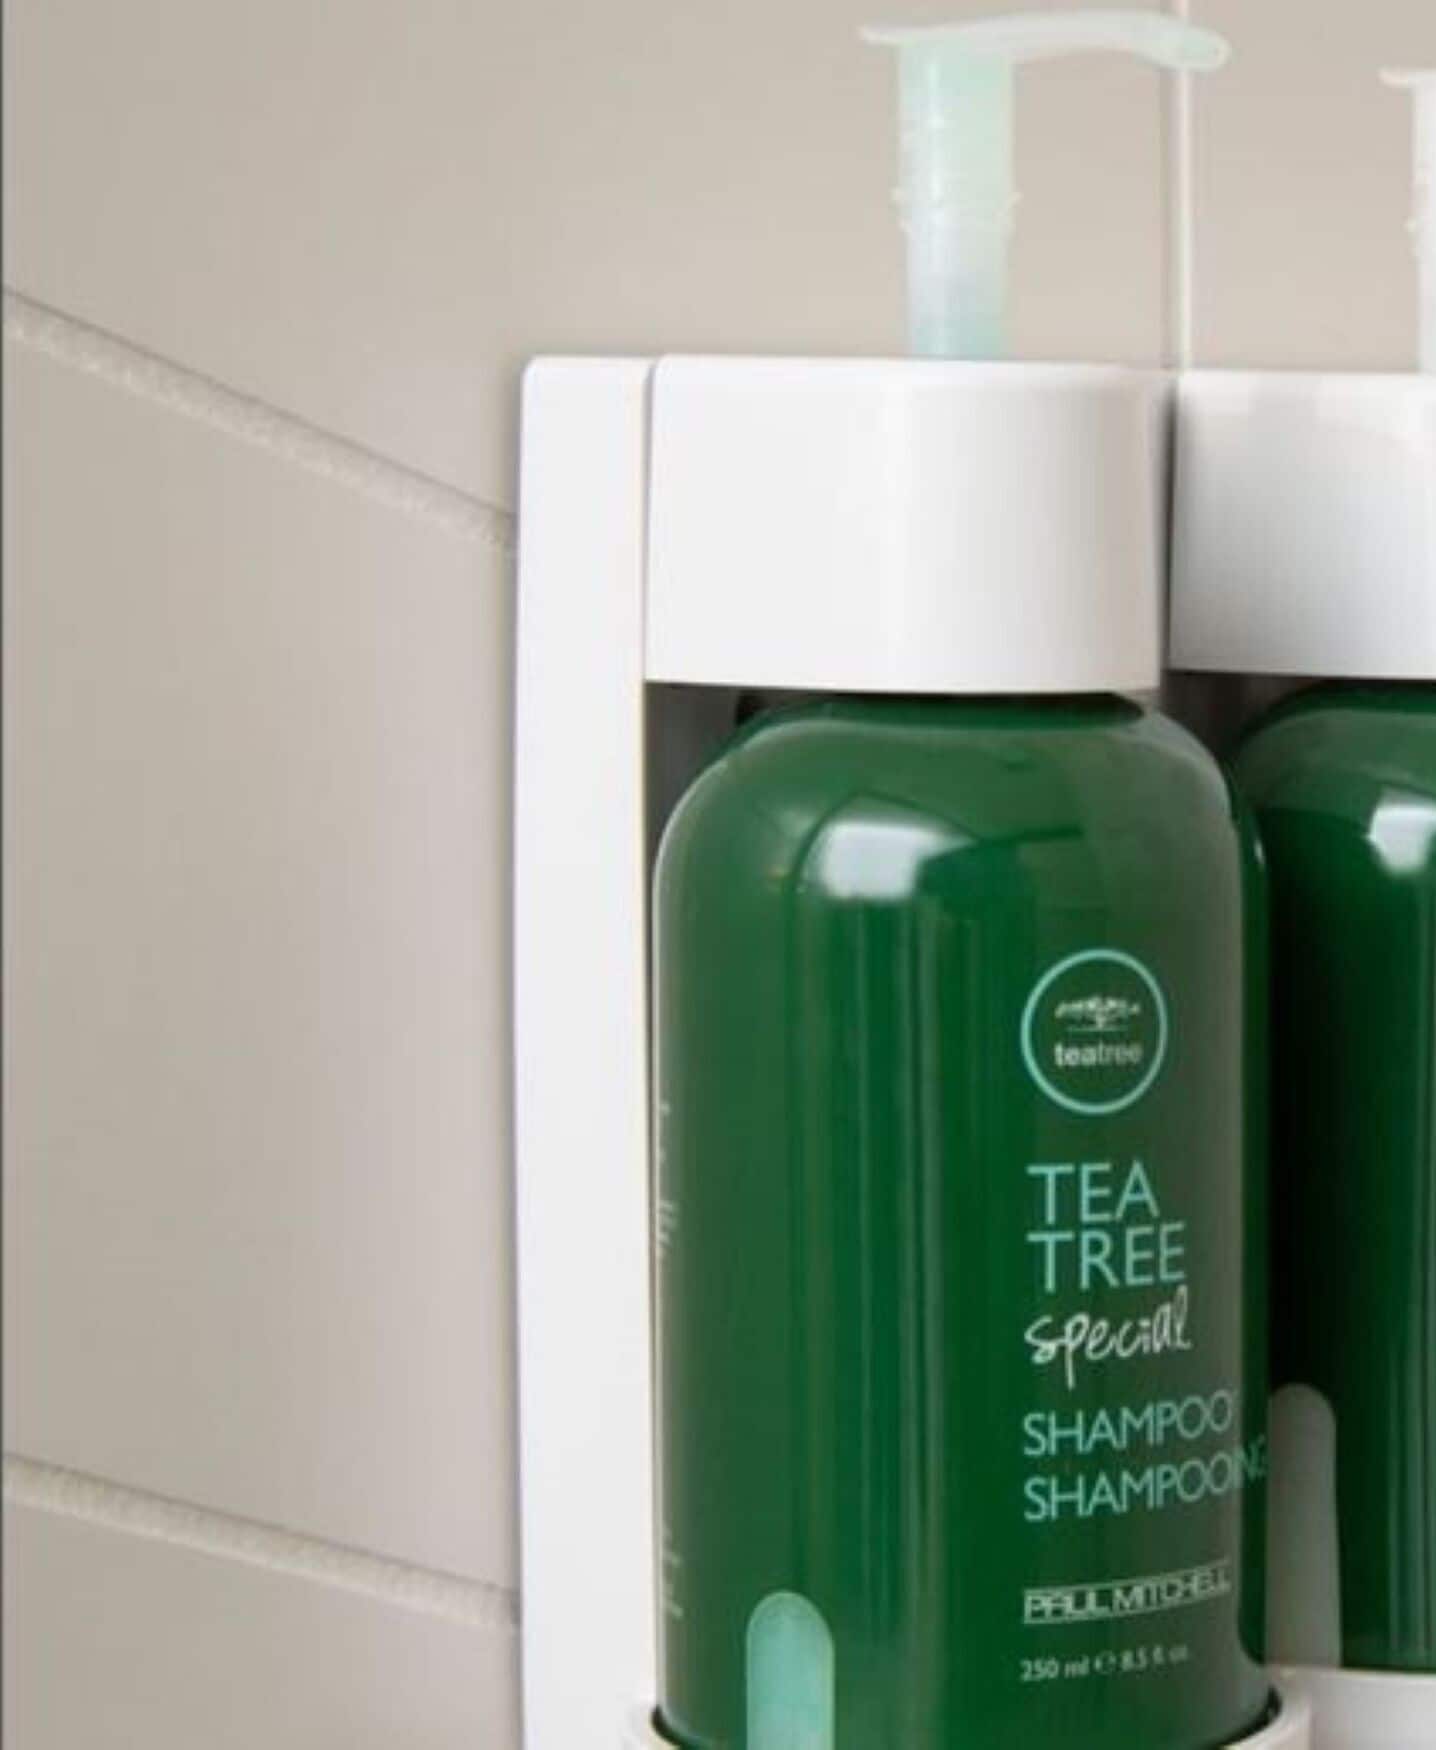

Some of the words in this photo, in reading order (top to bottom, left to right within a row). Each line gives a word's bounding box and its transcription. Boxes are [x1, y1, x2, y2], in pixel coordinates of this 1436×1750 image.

[1054, 1042, 1143, 1067] teatree
[1026, 1160, 1158, 1225] TEA
[1026, 1222, 1187, 1293] TREE
[1024, 1286, 1193, 1390] special
[1023, 1389, 1232, 1457] SHAMPOO
[1023, 1584, 1110, 1625] PAUL
[1020, 1657, 1060, 1684] 250
[1064, 1653, 1091, 1680] ml
